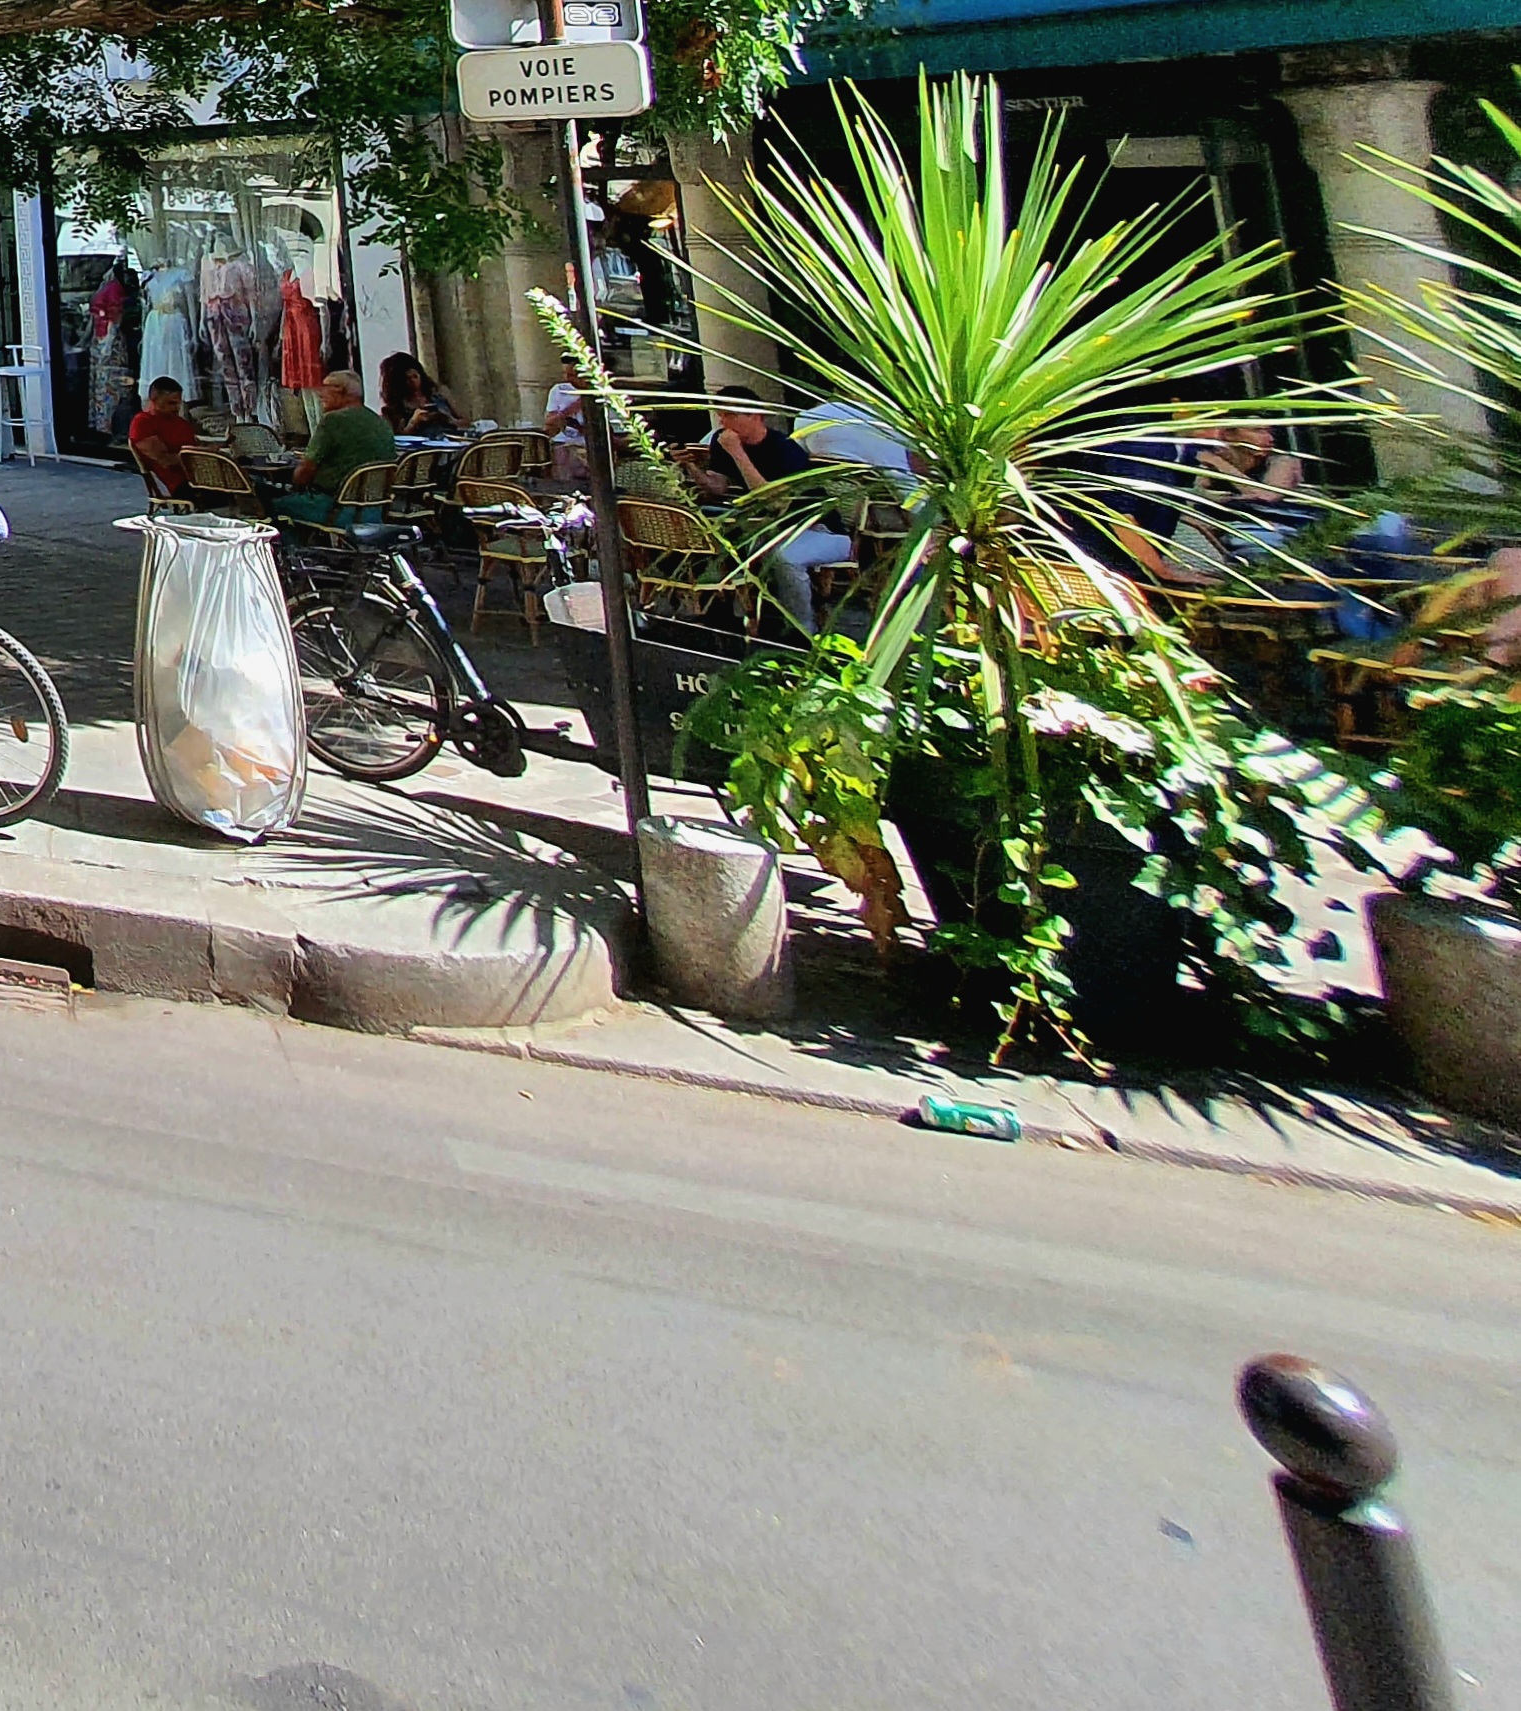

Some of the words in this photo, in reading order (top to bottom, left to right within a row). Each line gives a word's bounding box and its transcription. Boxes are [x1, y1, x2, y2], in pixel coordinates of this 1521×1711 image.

[519, 57, 576, 78] VOIE
[489, 83, 615, 108] POMPIERS
[1004, 95, 1085, 112] SENTIER
